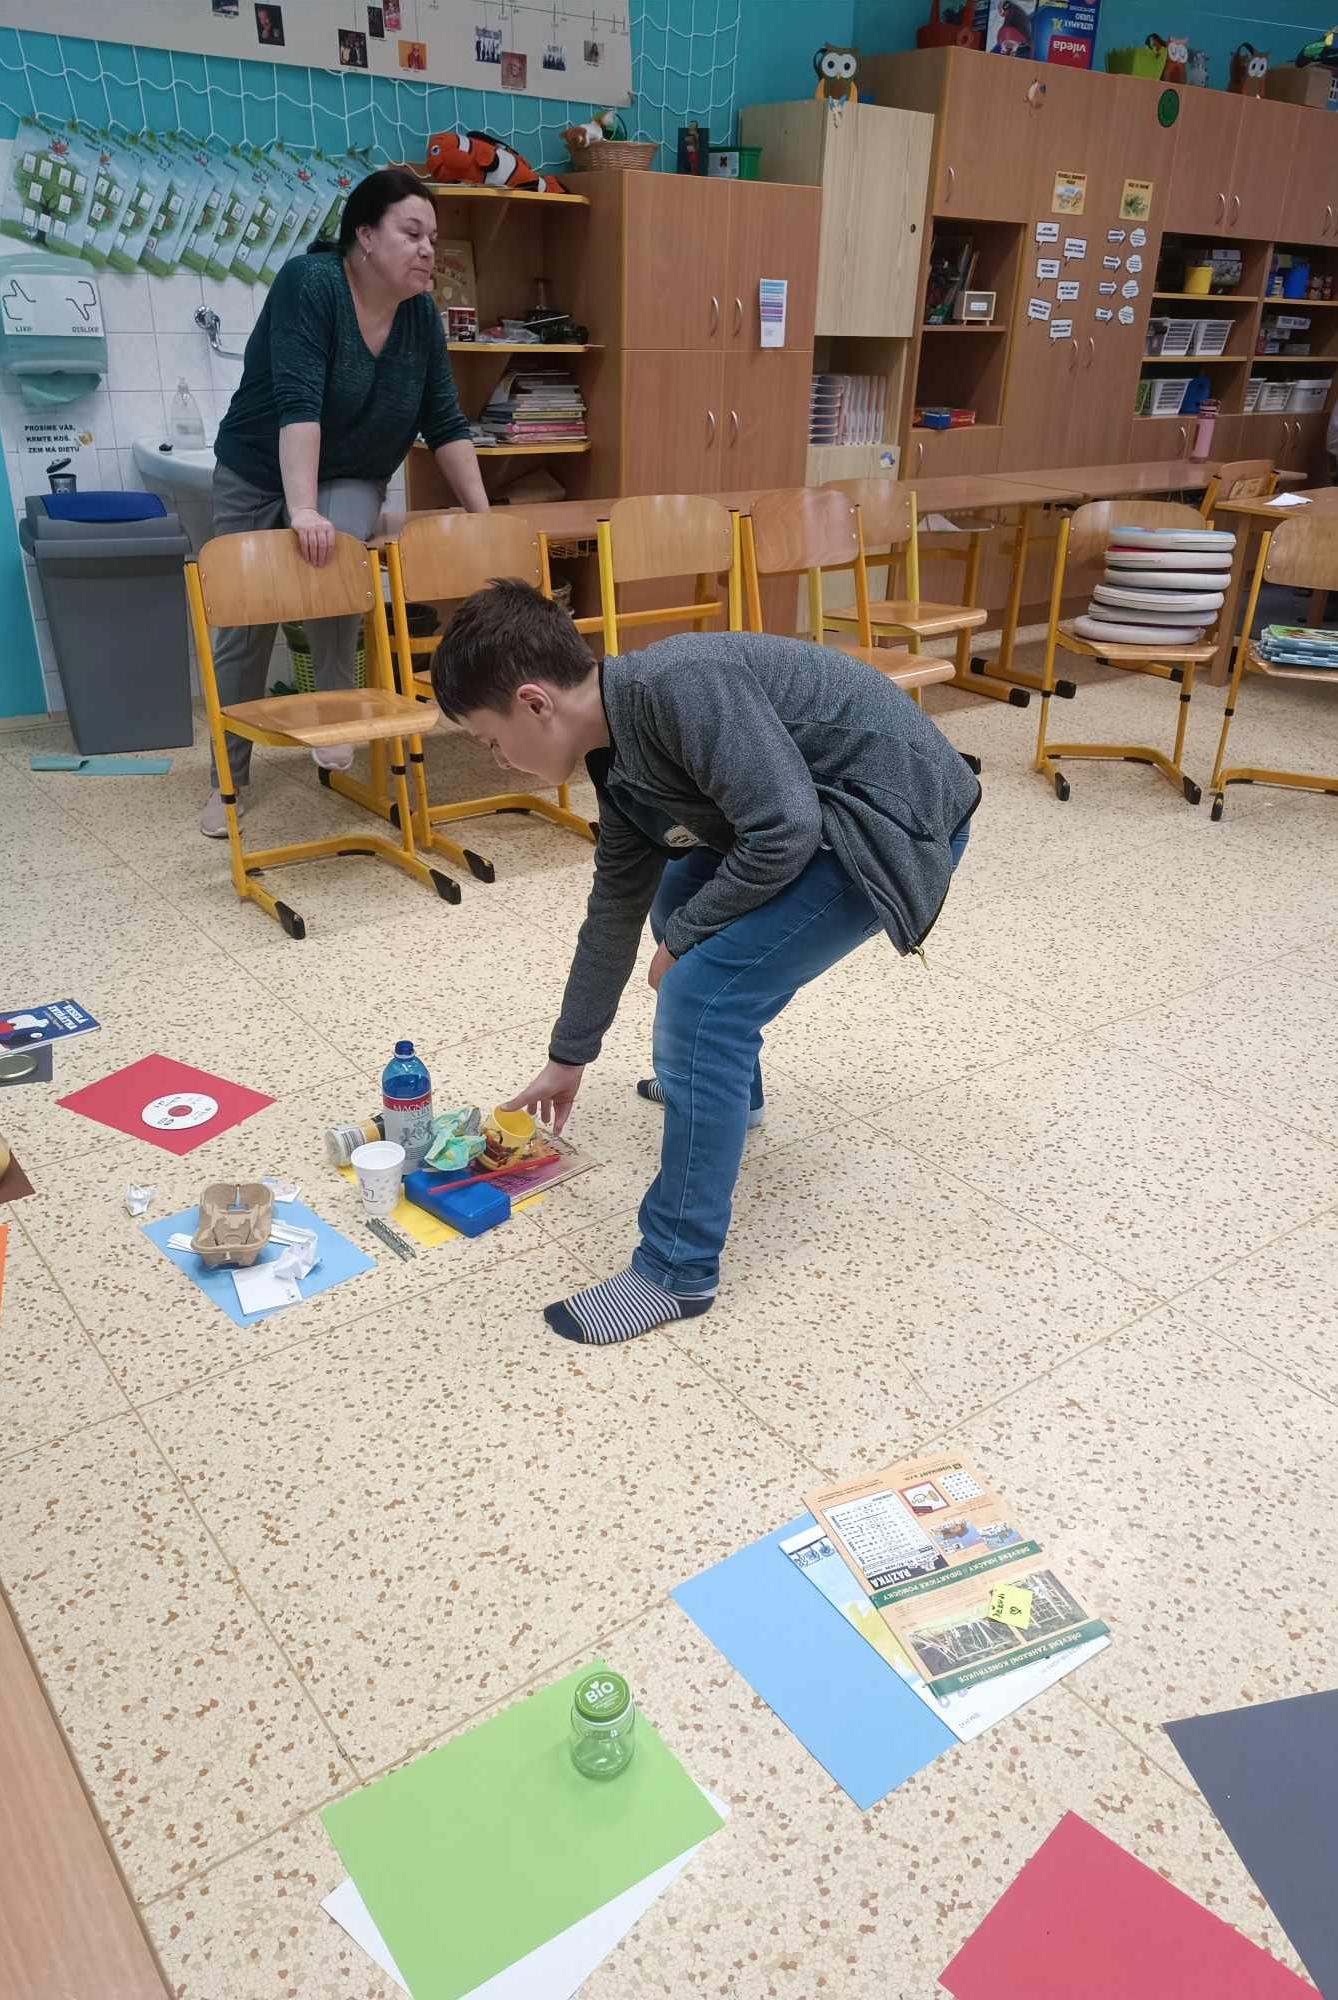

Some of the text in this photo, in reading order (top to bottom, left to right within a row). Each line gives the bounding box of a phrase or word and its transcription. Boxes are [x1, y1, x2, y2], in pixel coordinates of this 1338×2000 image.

[1053, 40, 1086, 53] vileda
[870, 1567, 911, 1589] RAZÍTKA
[957, 1658, 1009, 1684] KONSTRUKCE
[585, 1682, 614, 1704] BIO
